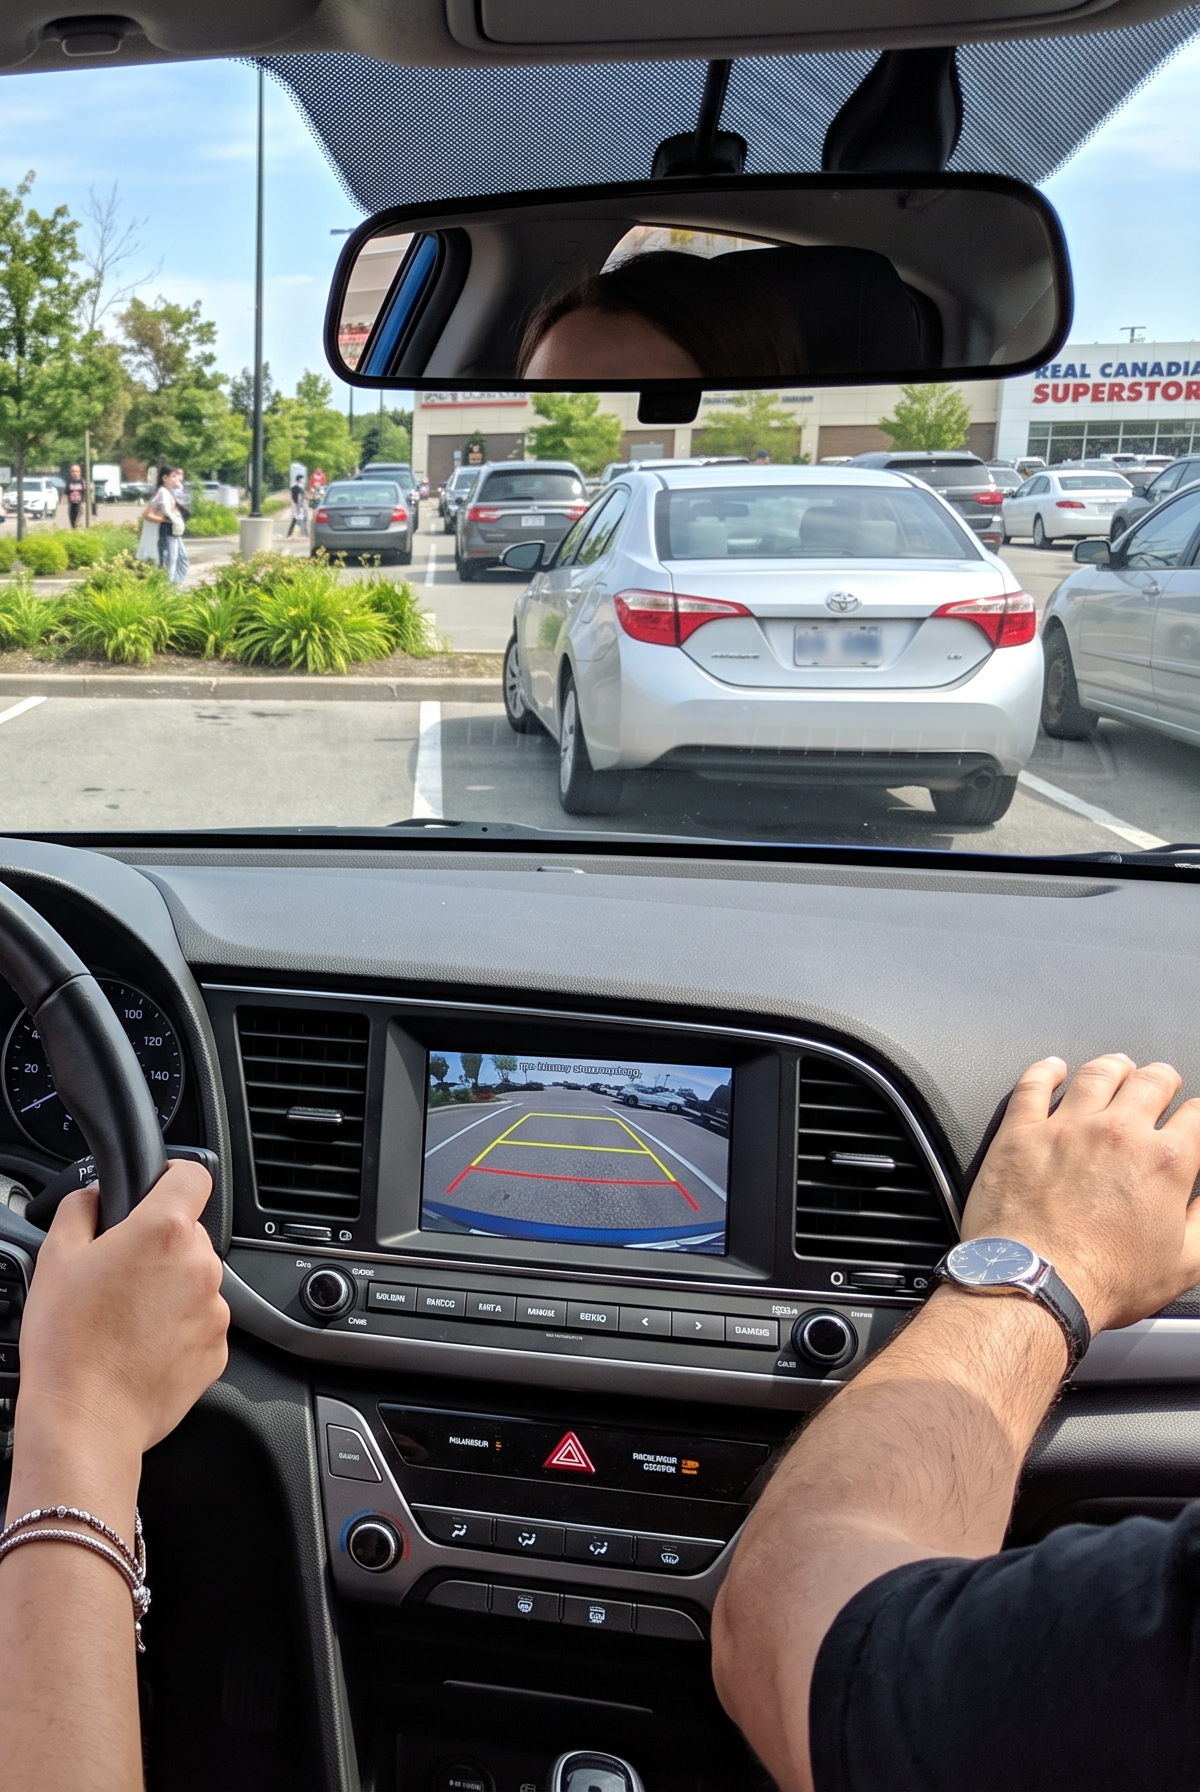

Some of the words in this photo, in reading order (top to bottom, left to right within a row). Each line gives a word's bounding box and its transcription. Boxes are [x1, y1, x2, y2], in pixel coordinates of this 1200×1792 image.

[1034, 363, 1091, 379] REAL
[124, 1009, 143, 1020] 100
[144, 1036, 162, 1047] 120
[24, 1063, 38, 1074] 20
[150, 1070, 170, 1081] 140
